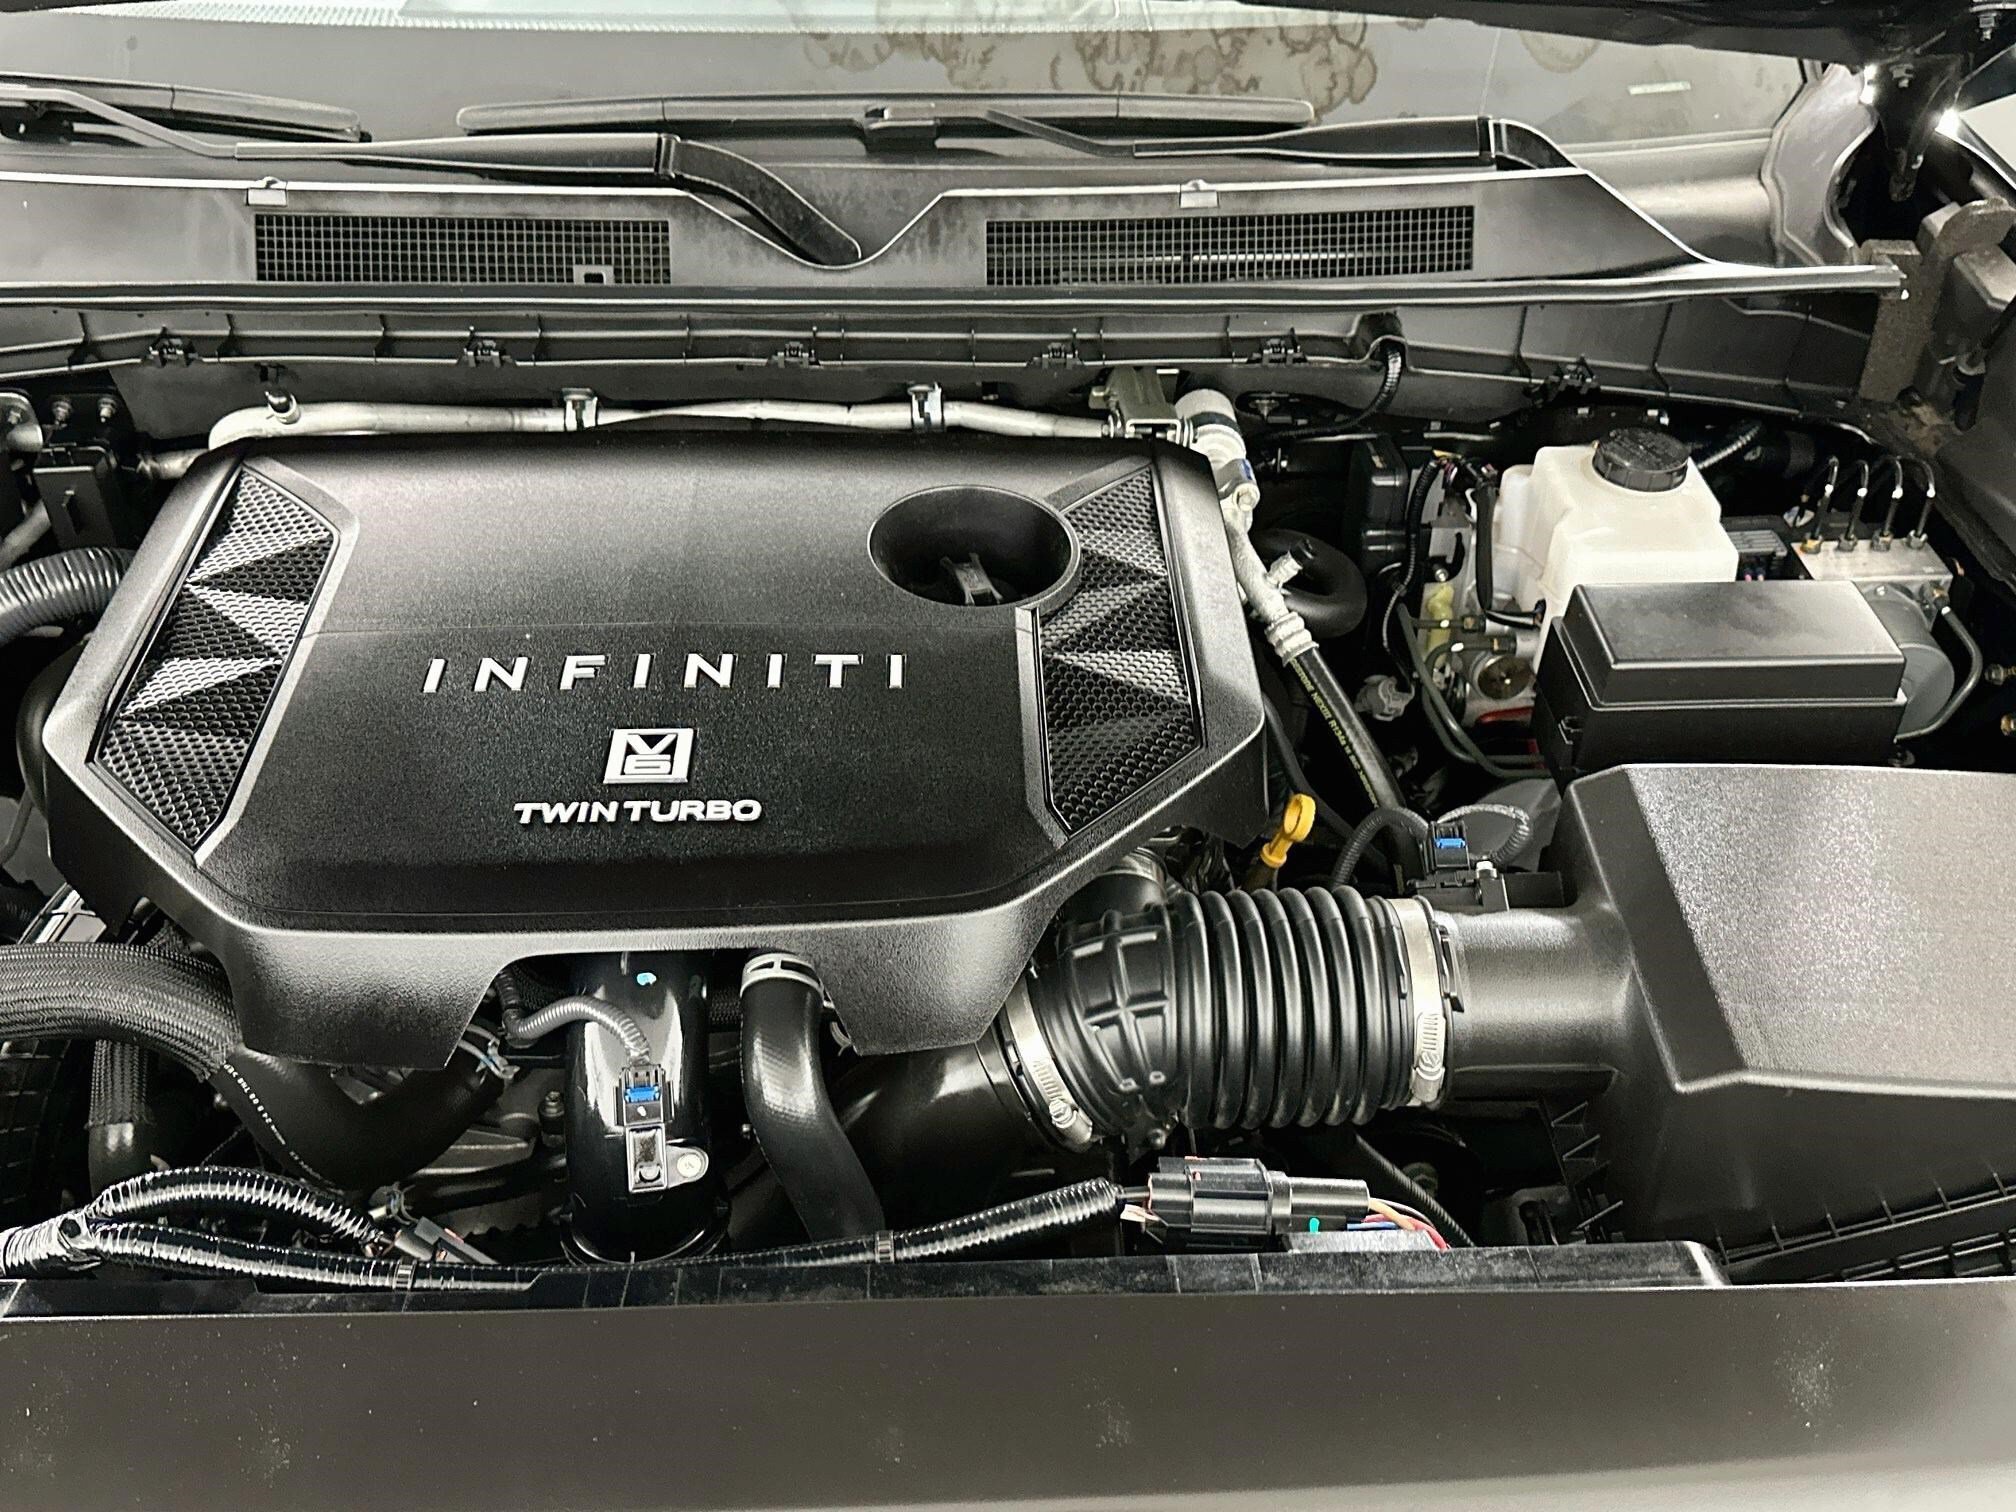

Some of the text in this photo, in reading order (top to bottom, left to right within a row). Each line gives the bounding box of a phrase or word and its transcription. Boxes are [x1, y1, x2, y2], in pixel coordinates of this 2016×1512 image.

[422, 653, 904, 693] INFINITI
[513, 799, 762, 824] TWIN TURBO
